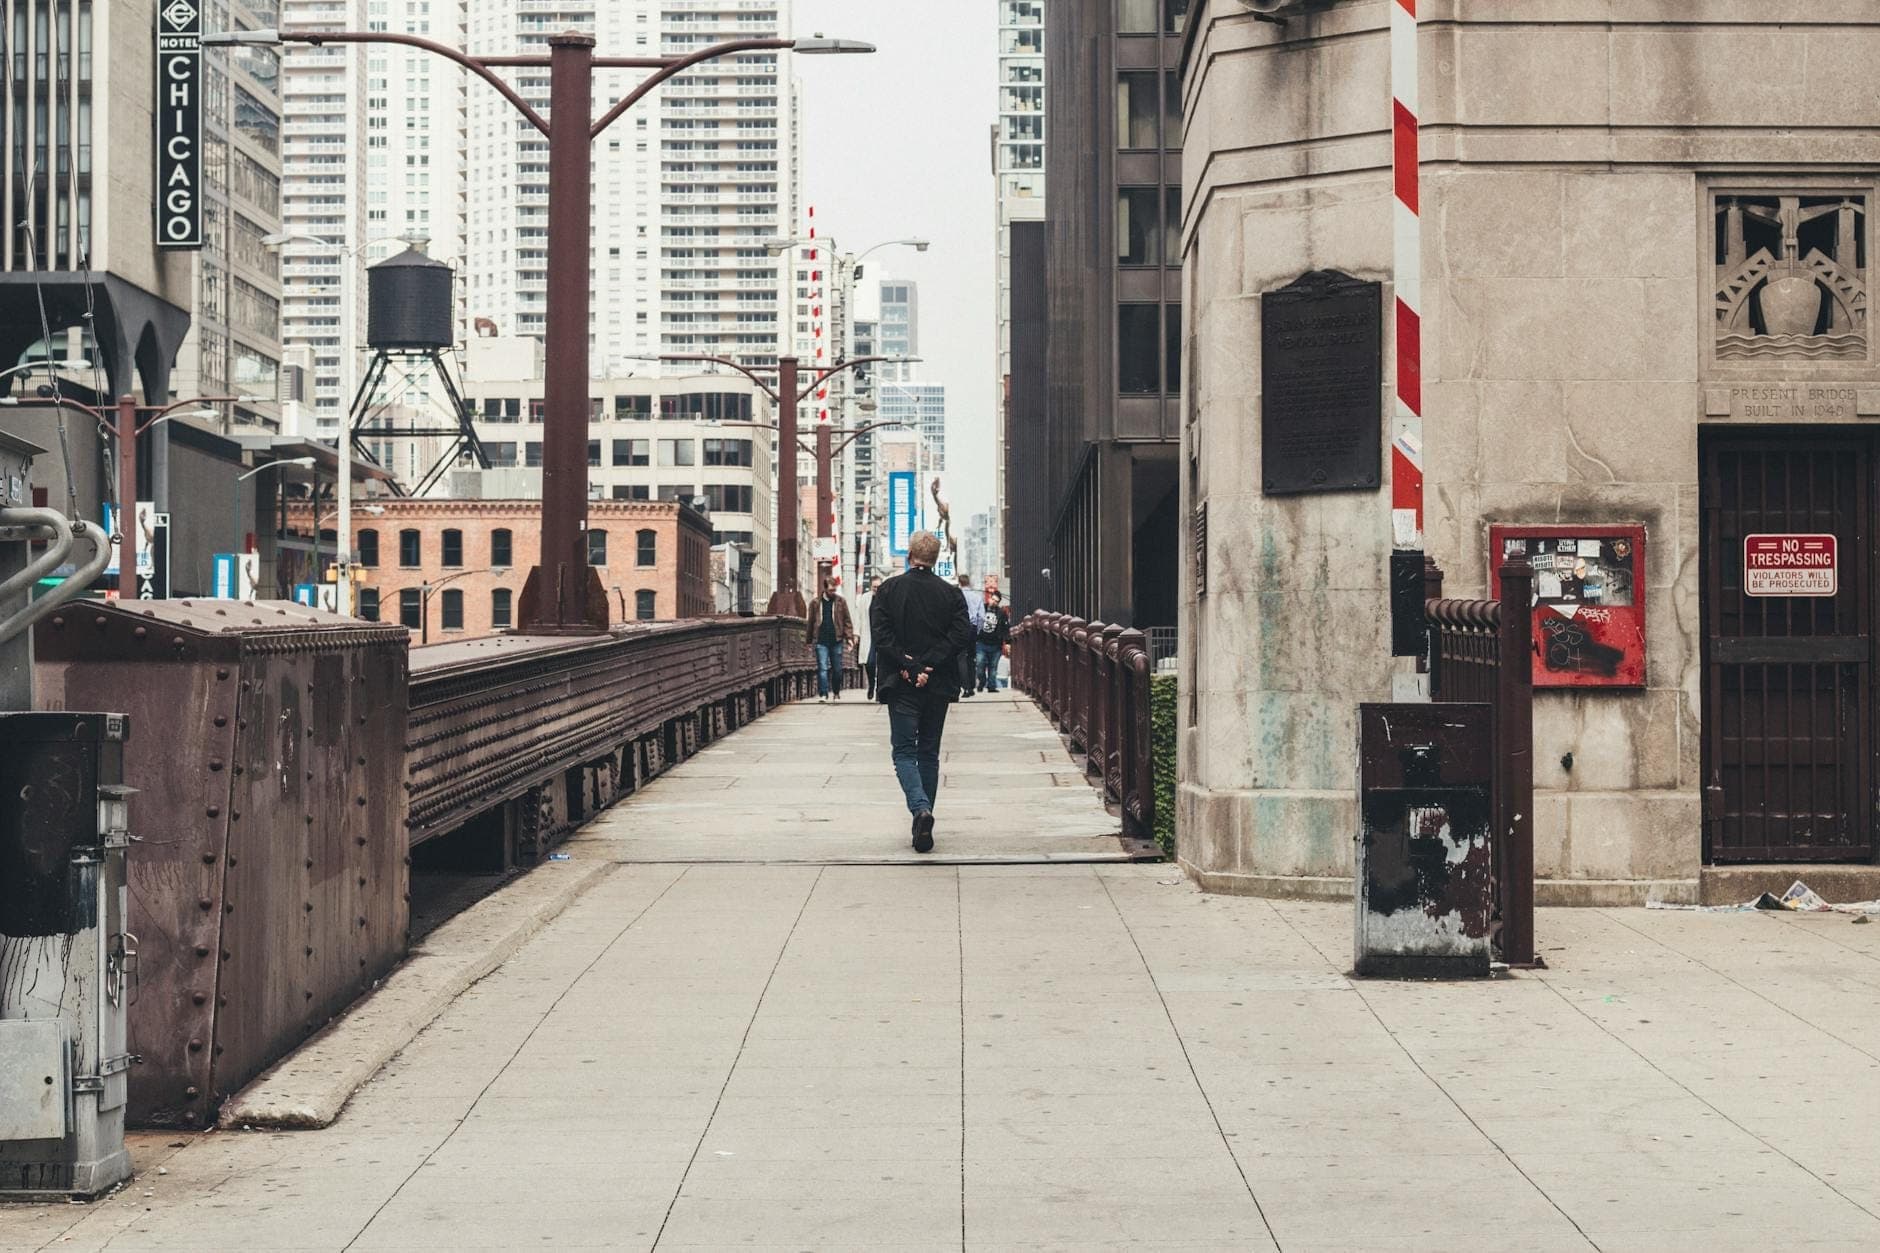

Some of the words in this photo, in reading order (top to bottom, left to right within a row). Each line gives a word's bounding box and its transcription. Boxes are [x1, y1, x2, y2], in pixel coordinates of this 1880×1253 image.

[160, 38, 198, 48] HOTEL
[167, 56, 192, 240] CHICAGO
[1732, 388, 1798, 400] PRESENT
[1808, 389, 1856, 400] BRIDGE
[1745, 405, 1782, 417] BUILT
[1791, 405, 1805, 417] IN
[1782, 539, 1799, 552] NO
[1750, 553, 1831, 565] TRESPASSING
[1752, 571, 1804, 580] VIOLATORS
[1808, 571, 1829, 580] WILL
[1752, 580, 1764, 588] BE
[1769, 580, 1830, 588] PROSECUTED
